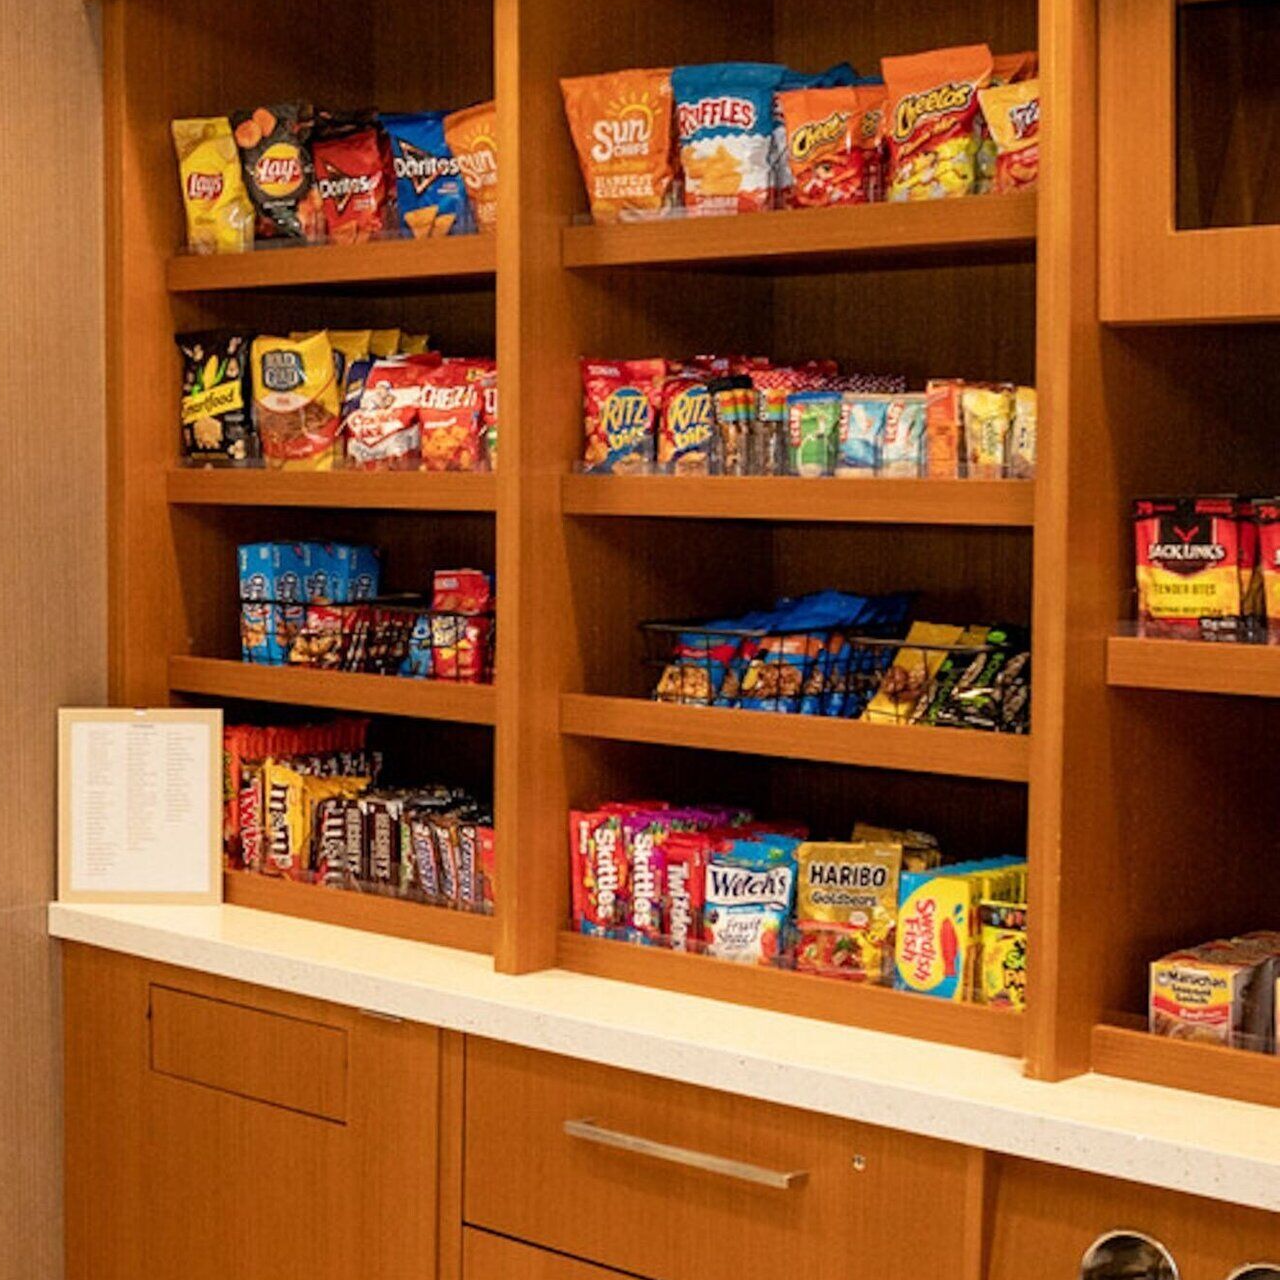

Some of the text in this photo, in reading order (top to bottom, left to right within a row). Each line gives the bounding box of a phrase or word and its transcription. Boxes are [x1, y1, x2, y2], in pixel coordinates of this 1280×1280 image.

[679, 96, 754, 134] RUFFLES
[896, 84, 972, 139] Cheetos
[591, 119, 652, 162] Sun
[393, 156, 460, 179] Doritos
[604, 396, 649, 433] RITZ
[668, 393, 712, 432] RITZ
[1148, 543, 1183, 560] JACK
[594, 828, 619, 919] Skittles
[633, 832, 655, 927] Skittles
[710, 870, 788, 898] Welch's
[809, 865, 887, 887] HARIBO
